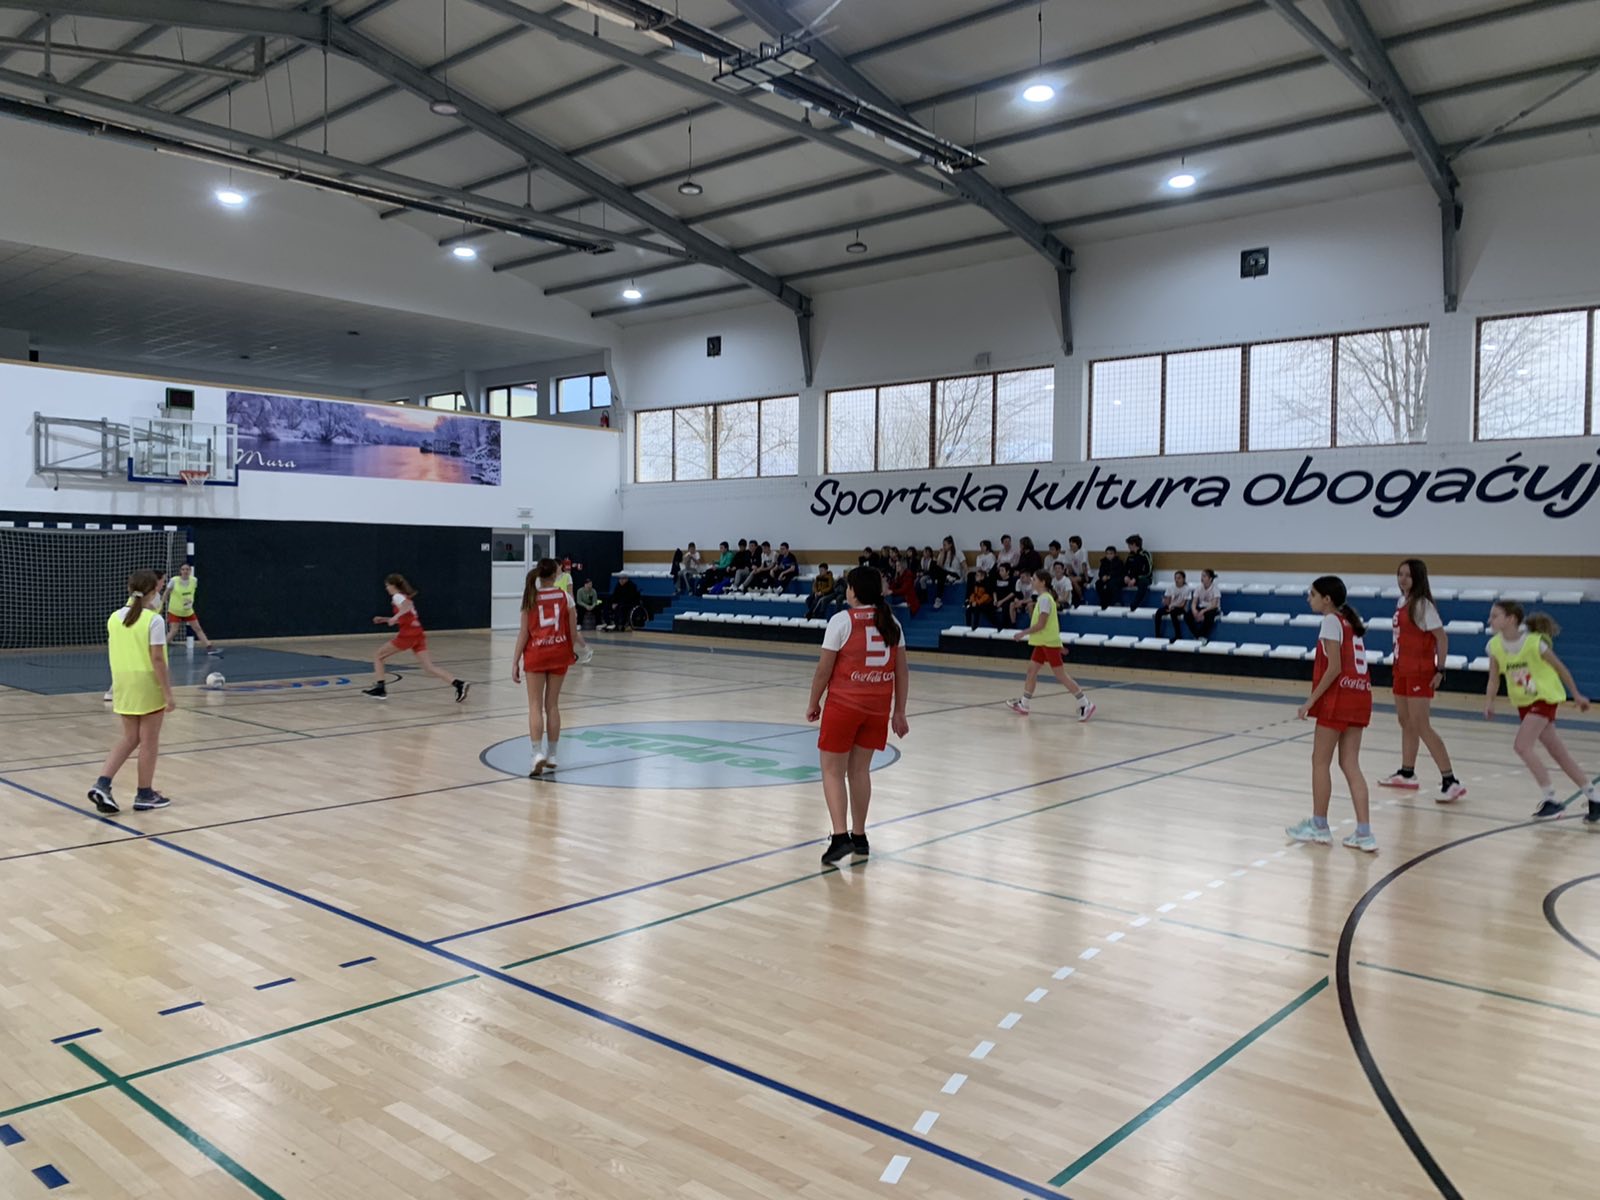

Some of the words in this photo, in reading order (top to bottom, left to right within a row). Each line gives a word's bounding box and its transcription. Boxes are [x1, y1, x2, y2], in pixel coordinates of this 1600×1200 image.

[236, 447, 297, 469] Mura
[809, 469, 1010, 526] Sportska
[1014, 464, 1232, 514] kultura
[1241, 447, 1600, 520] obogaćuj
[538, 602, 560, 632] 4
[865, 625, 891, 667] 5
